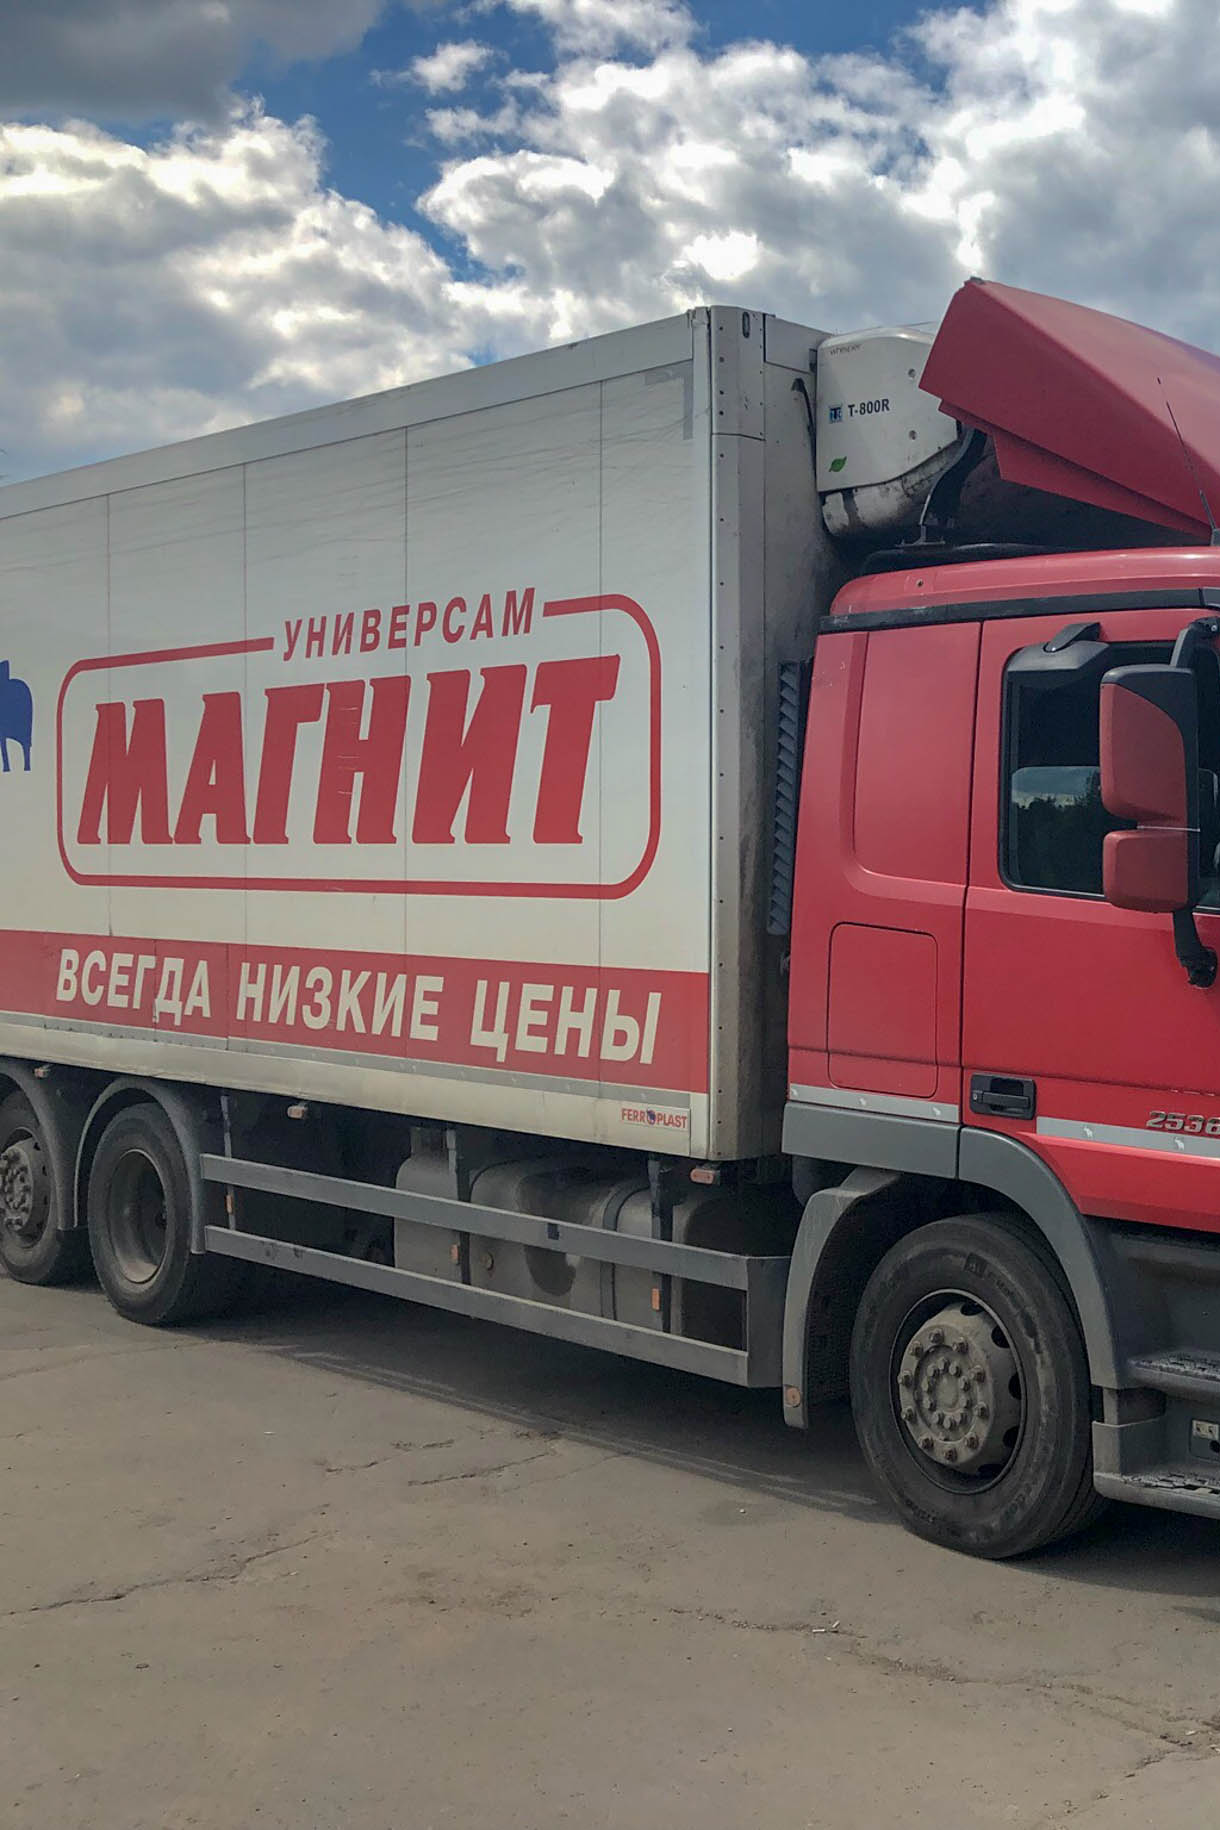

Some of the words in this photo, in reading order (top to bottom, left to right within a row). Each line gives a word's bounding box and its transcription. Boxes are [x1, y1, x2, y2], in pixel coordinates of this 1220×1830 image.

[847, 398, 890, 417] T-800R
[282, 587, 536, 661] УНИВЕРСАМ
[76, 654, 621, 844] МАГНИТ
[56, 949, 212, 1026] ВСЕГДА
[235, 962, 444, 1042] НИЗКИЕ
[470, 980, 662, 1065] ЦЕНЫ
